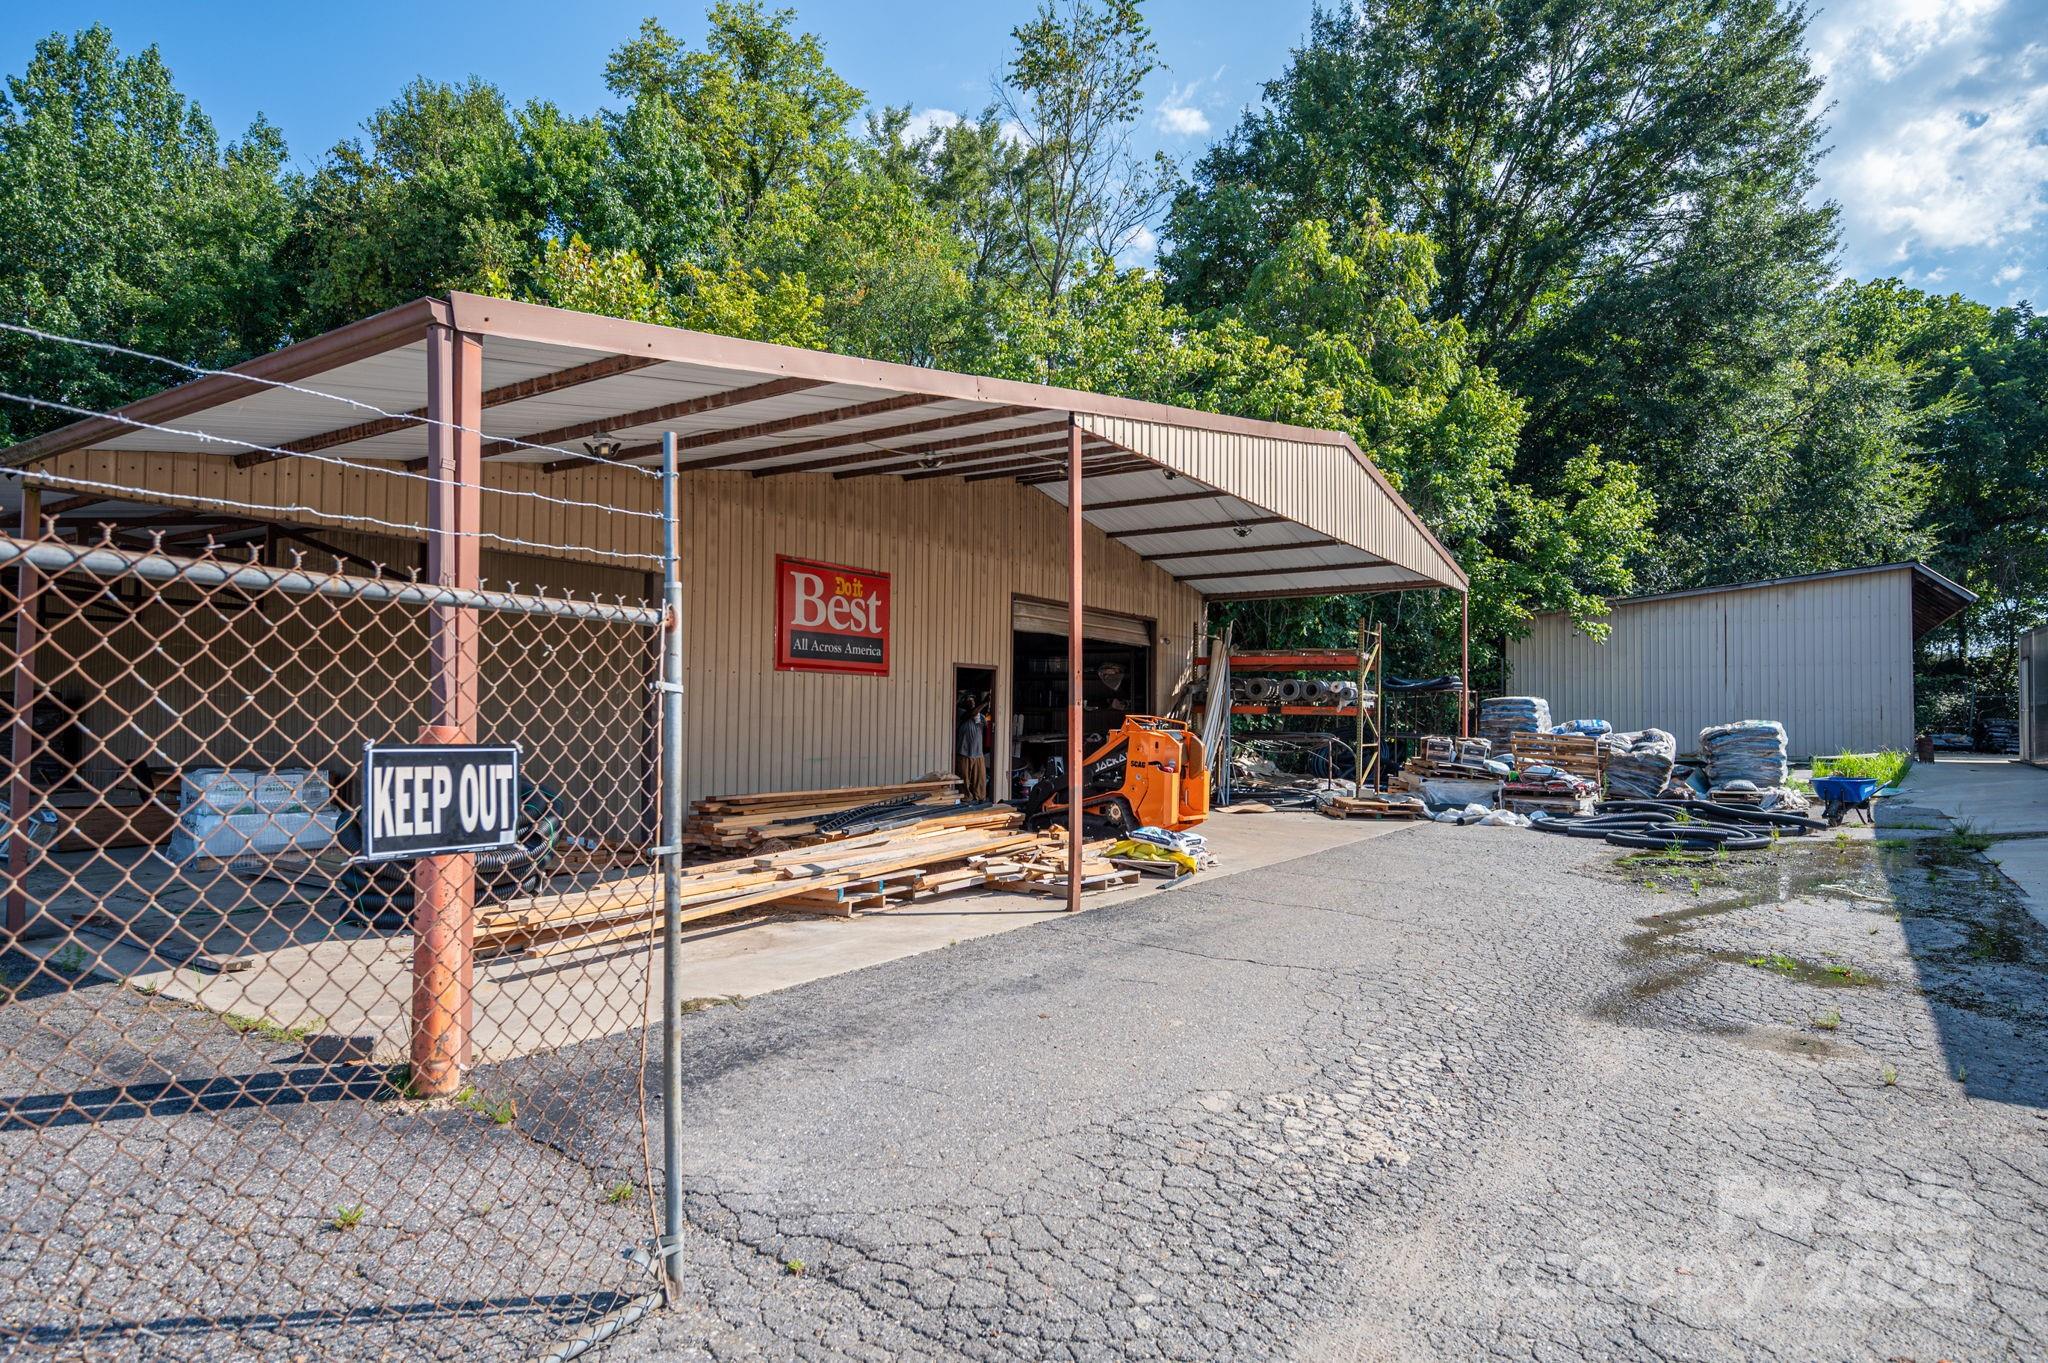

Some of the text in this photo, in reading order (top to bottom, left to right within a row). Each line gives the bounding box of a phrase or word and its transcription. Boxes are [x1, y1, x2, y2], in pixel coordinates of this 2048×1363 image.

[835, 576, 863, 597] Do it
[790, 571, 882, 634] Best
[793, 638, 881, 656] All Across America
[1095, 752, 1128, 773] JACKA
[1130, 760, 1146, 769] SCAG
[373, 763, 513, 838] KEEP OUT
